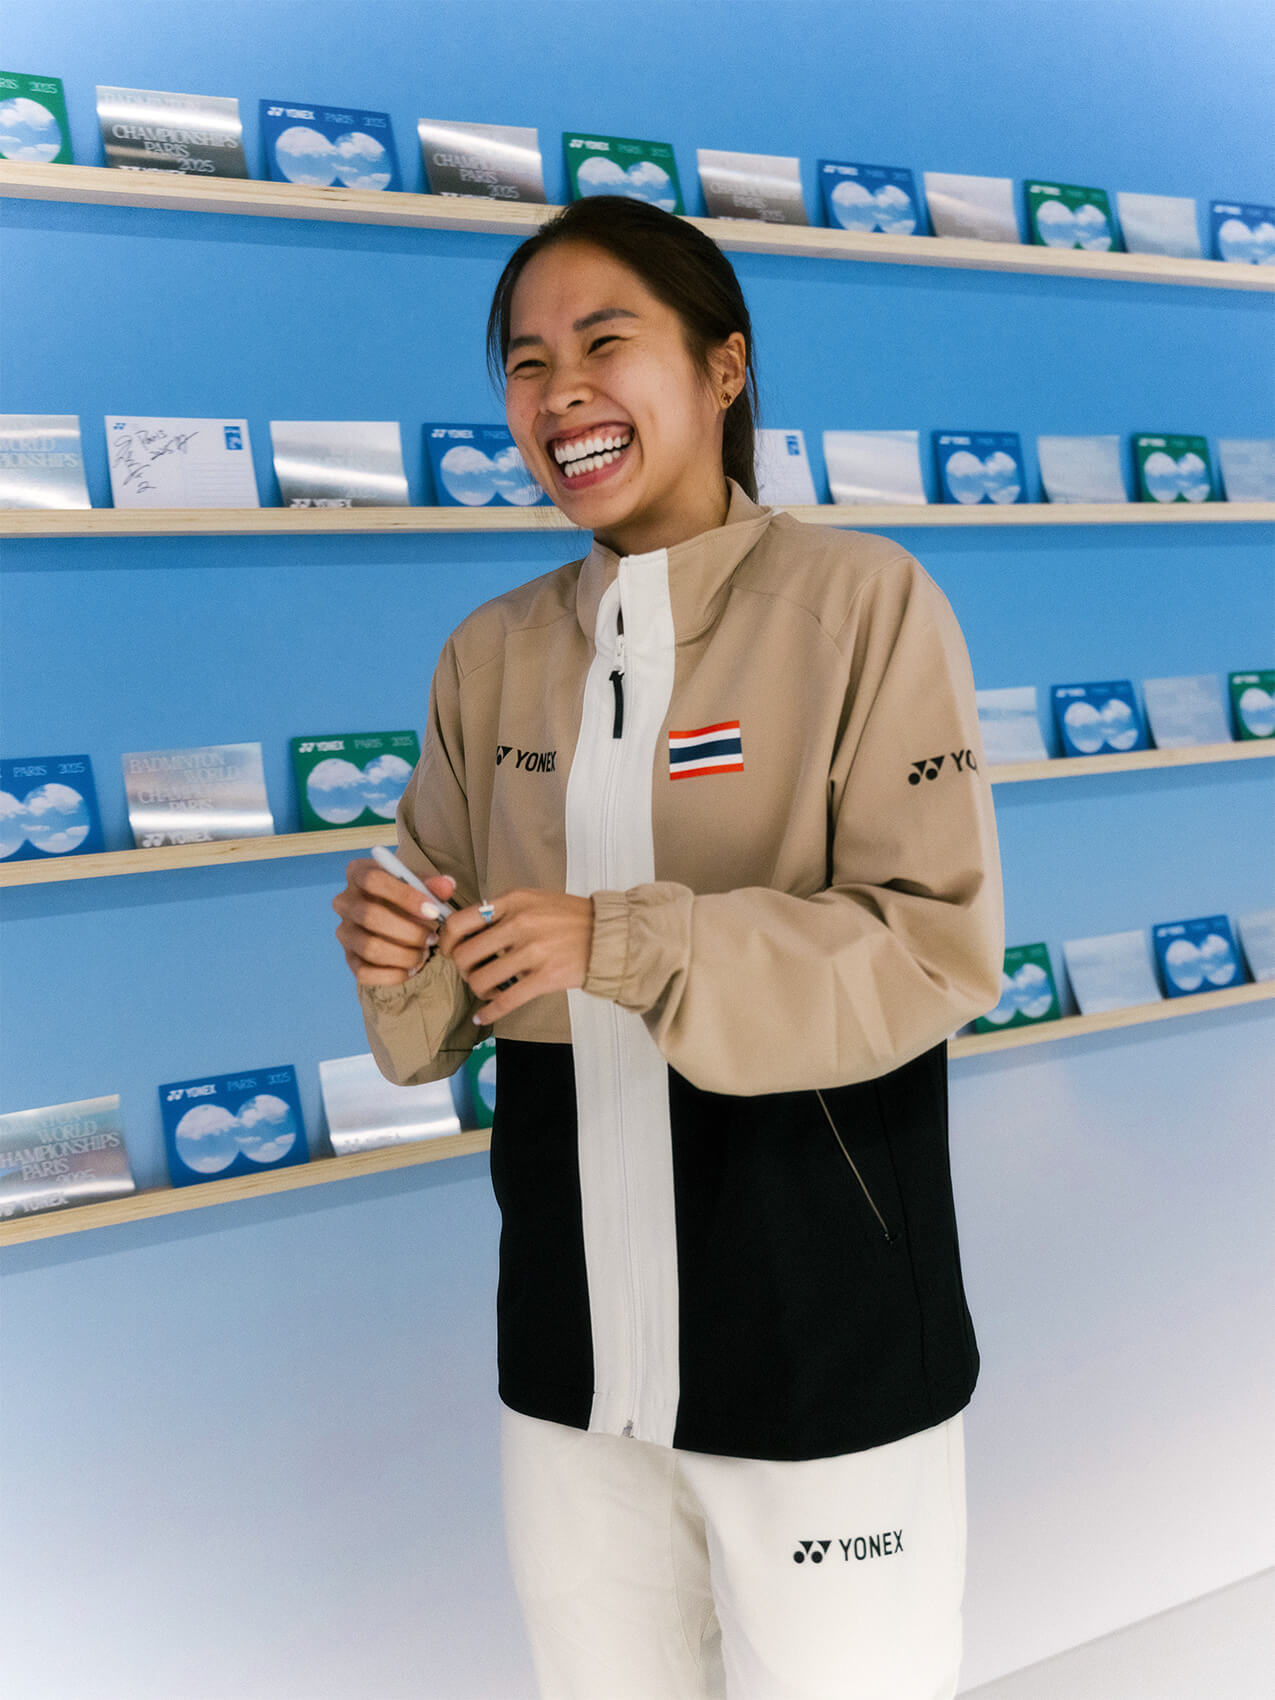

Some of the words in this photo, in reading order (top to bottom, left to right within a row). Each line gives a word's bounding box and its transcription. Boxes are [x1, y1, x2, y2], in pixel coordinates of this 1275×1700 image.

[144, 141, 190, 158] PARIS
[178, 158, 215, 173] 2025
[13, 765, 47, 778] PARIS
[515, 748, 557, 773] YONEX
[950, 749, 979, 776] YO
[21, 1158, 70, 1180] PARIS
[838, 1529, 904, 1562] YONEX
